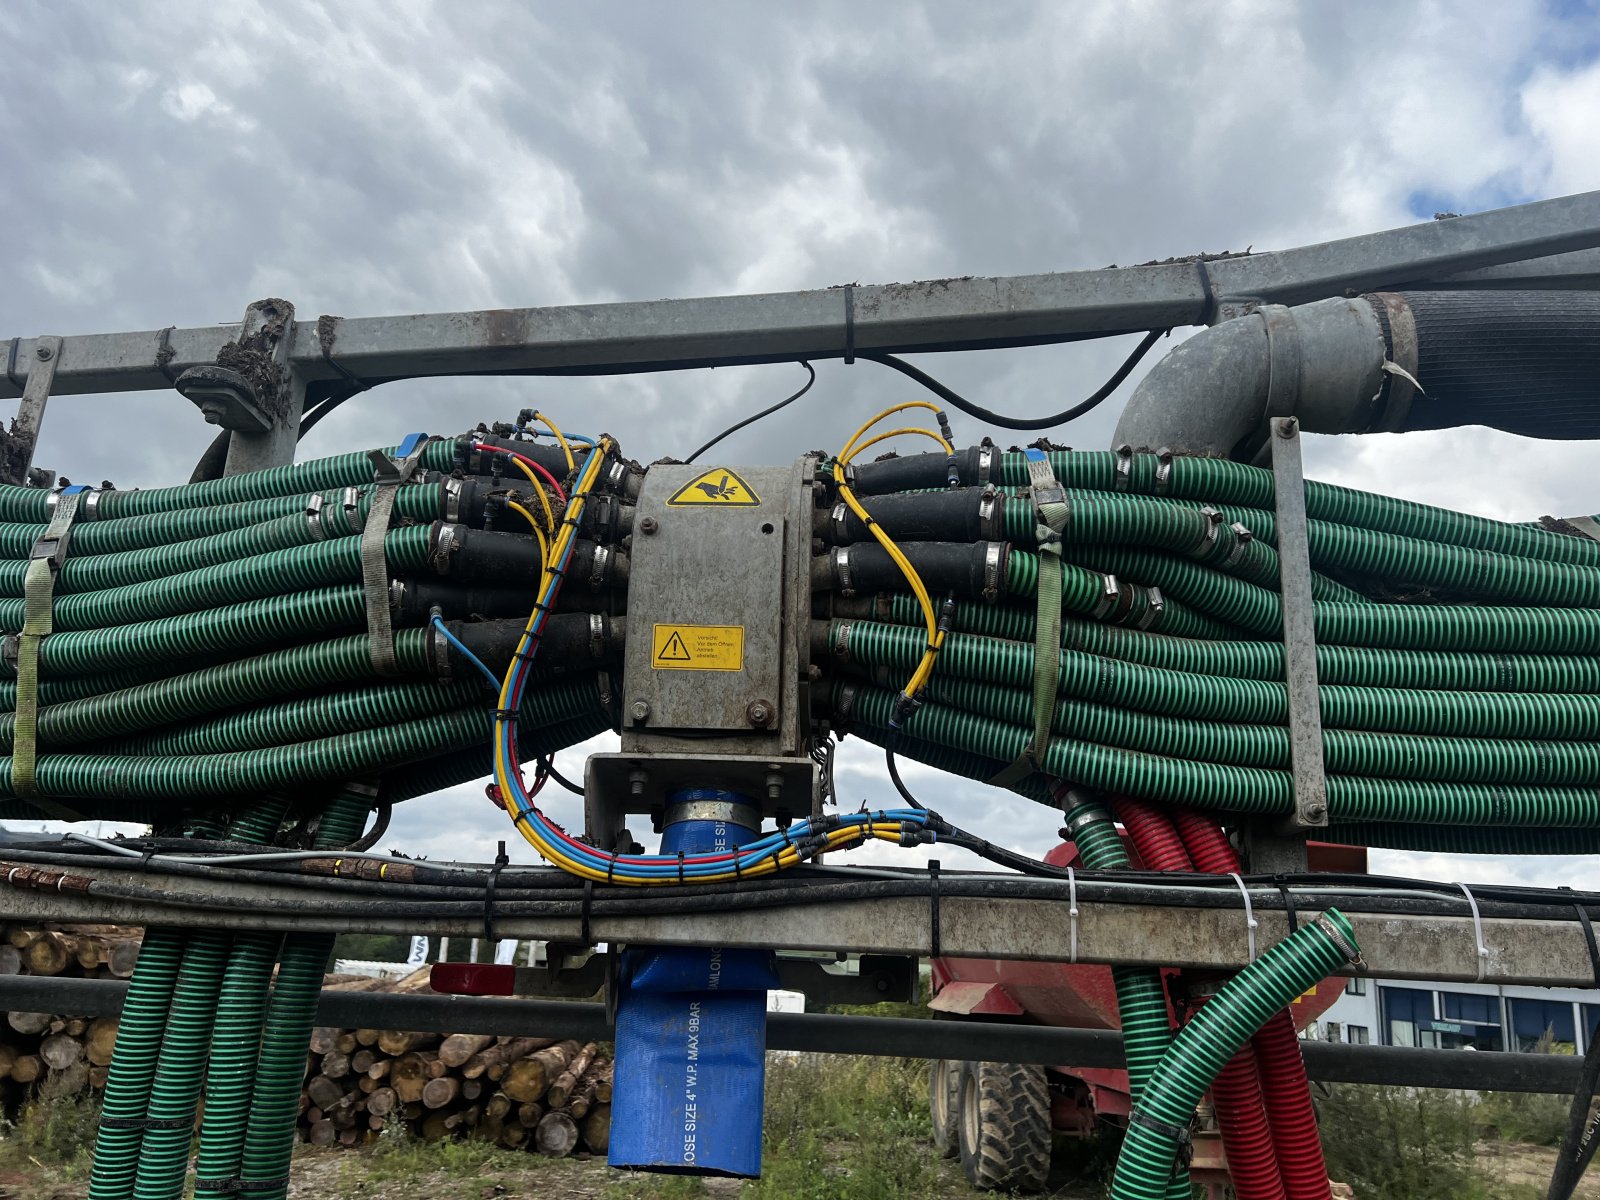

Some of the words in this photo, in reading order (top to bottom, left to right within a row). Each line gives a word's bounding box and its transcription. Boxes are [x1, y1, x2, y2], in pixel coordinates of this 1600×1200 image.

[688, 1001, 701, 1032] 9BAR
[687, 1034, 699, 1061] MAX
[686, 1063, 698, 1087] W.P.
[685, 1089, 697, 1101] 4"
[685, 1103, 696, 1132] SIZE
[683, 1134, 696, 1166] OSE
